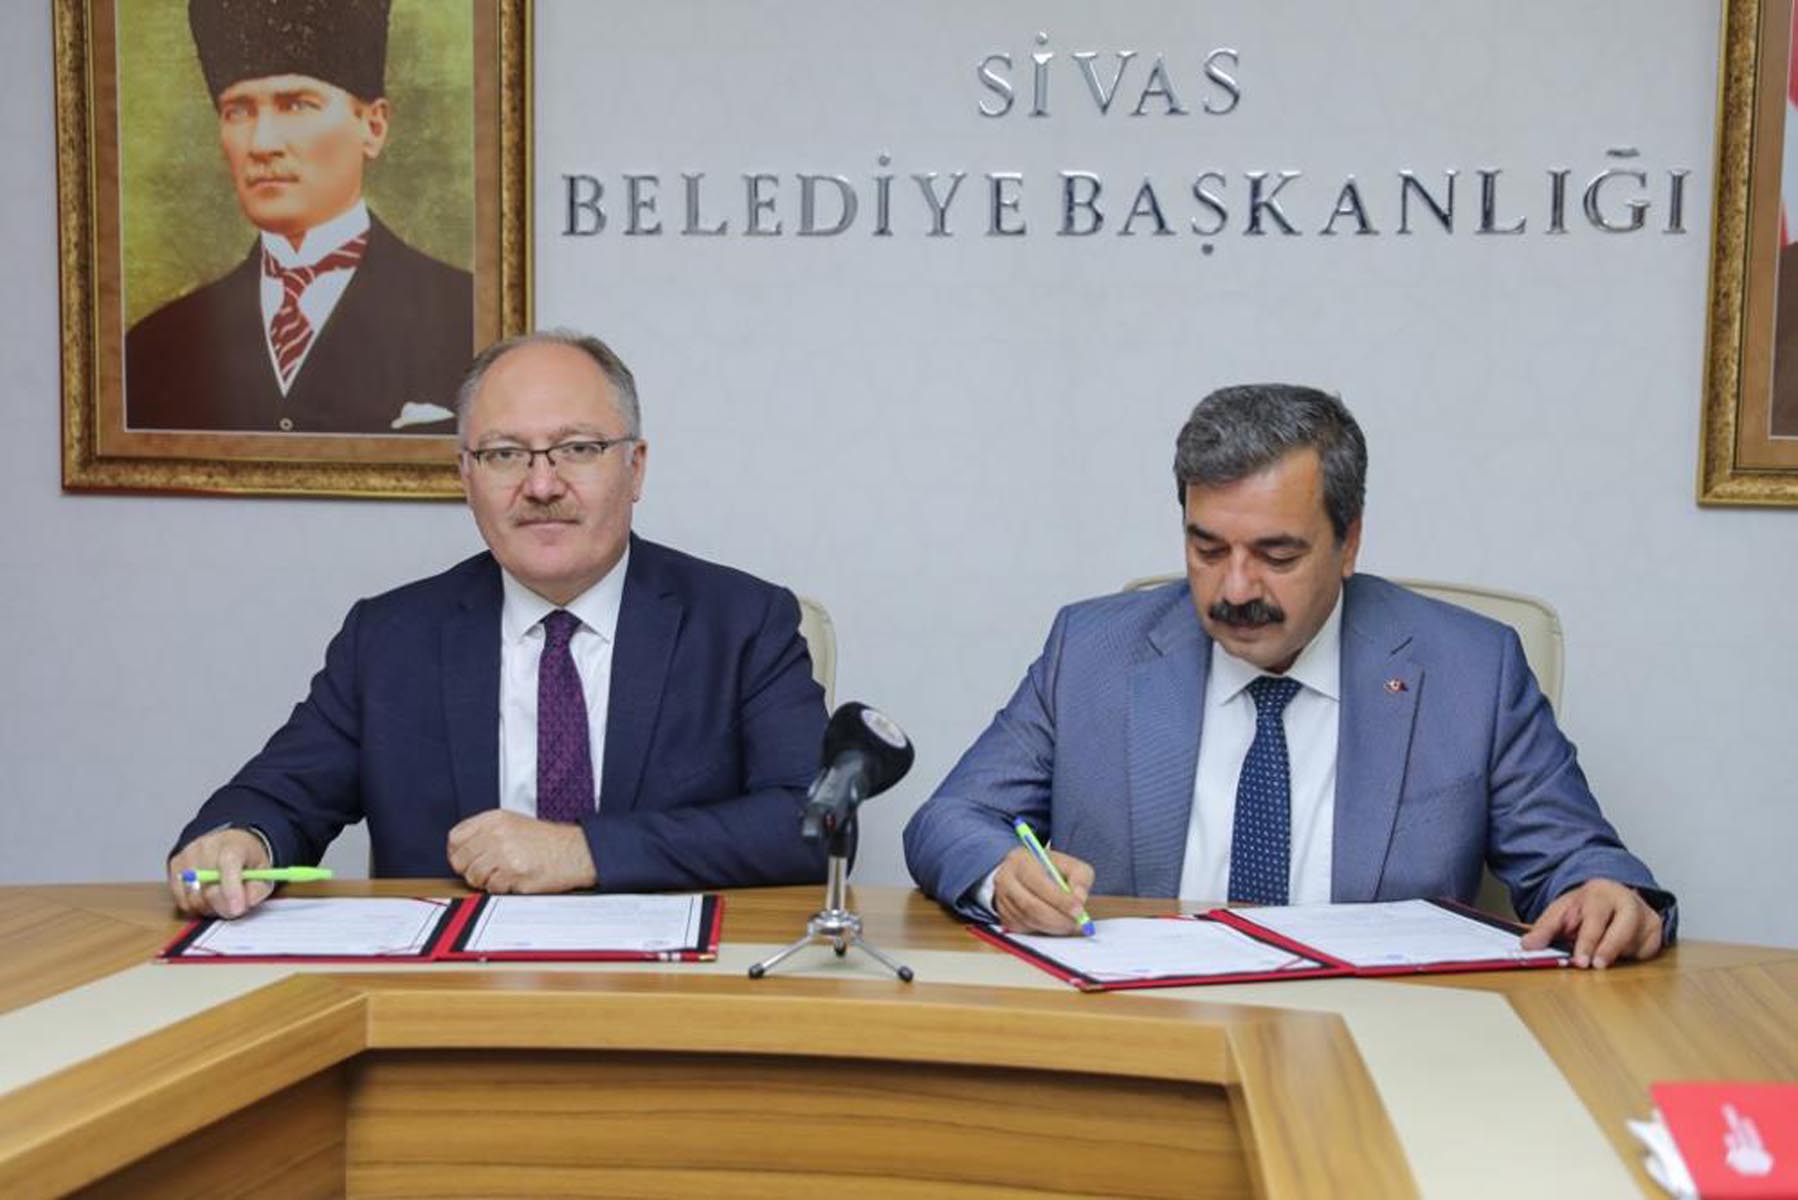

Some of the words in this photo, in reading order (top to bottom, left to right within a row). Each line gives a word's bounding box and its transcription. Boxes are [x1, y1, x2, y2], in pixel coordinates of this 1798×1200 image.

[976, 31, 1243, 118] SİVAS
[561, 152, 1027, 237] BELEDİYE
[1056, 147, 1693, 256] BAŞKANLIĞI
